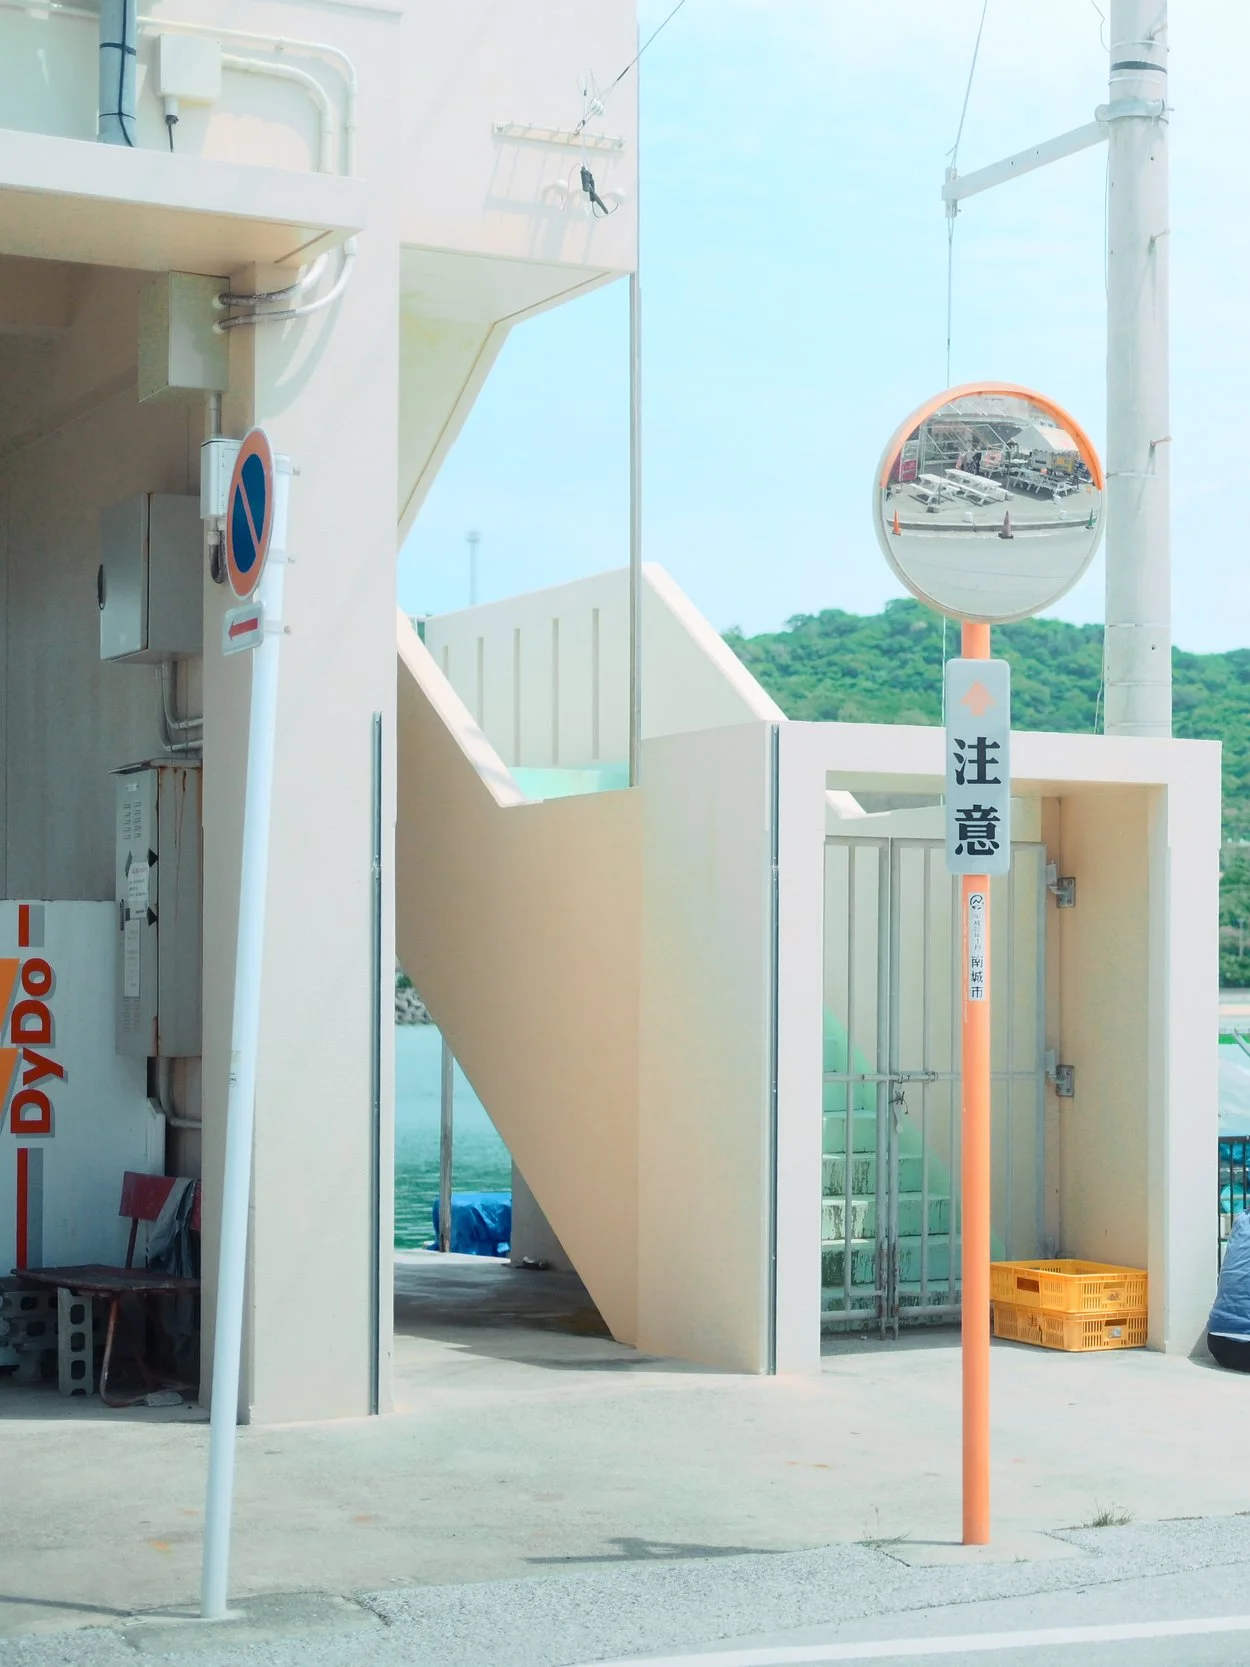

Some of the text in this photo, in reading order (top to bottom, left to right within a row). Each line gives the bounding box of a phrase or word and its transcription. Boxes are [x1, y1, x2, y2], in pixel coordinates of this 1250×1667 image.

[953, 736, 1001, 855] 注意
[971, 956, 984, 999] 南城市
[10, 958, 63, 1133] DyDo
